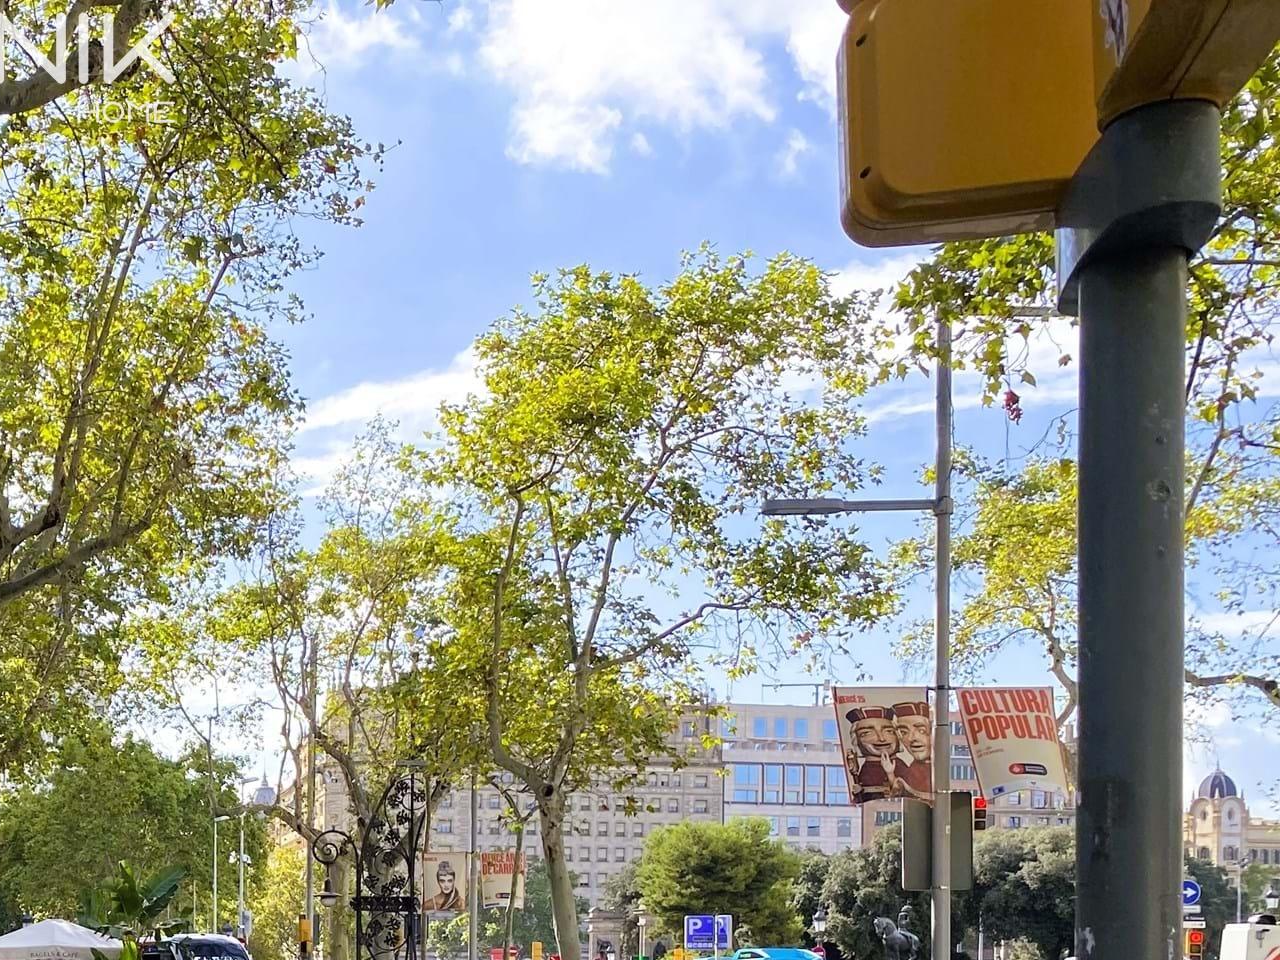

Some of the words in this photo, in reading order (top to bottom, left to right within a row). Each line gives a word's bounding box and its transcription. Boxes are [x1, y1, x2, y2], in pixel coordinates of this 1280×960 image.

[961, 689, 1051, 716] CULTURA
[968, 714, 1058, 745] POPULAR
[689, 919, 702, 936] P
